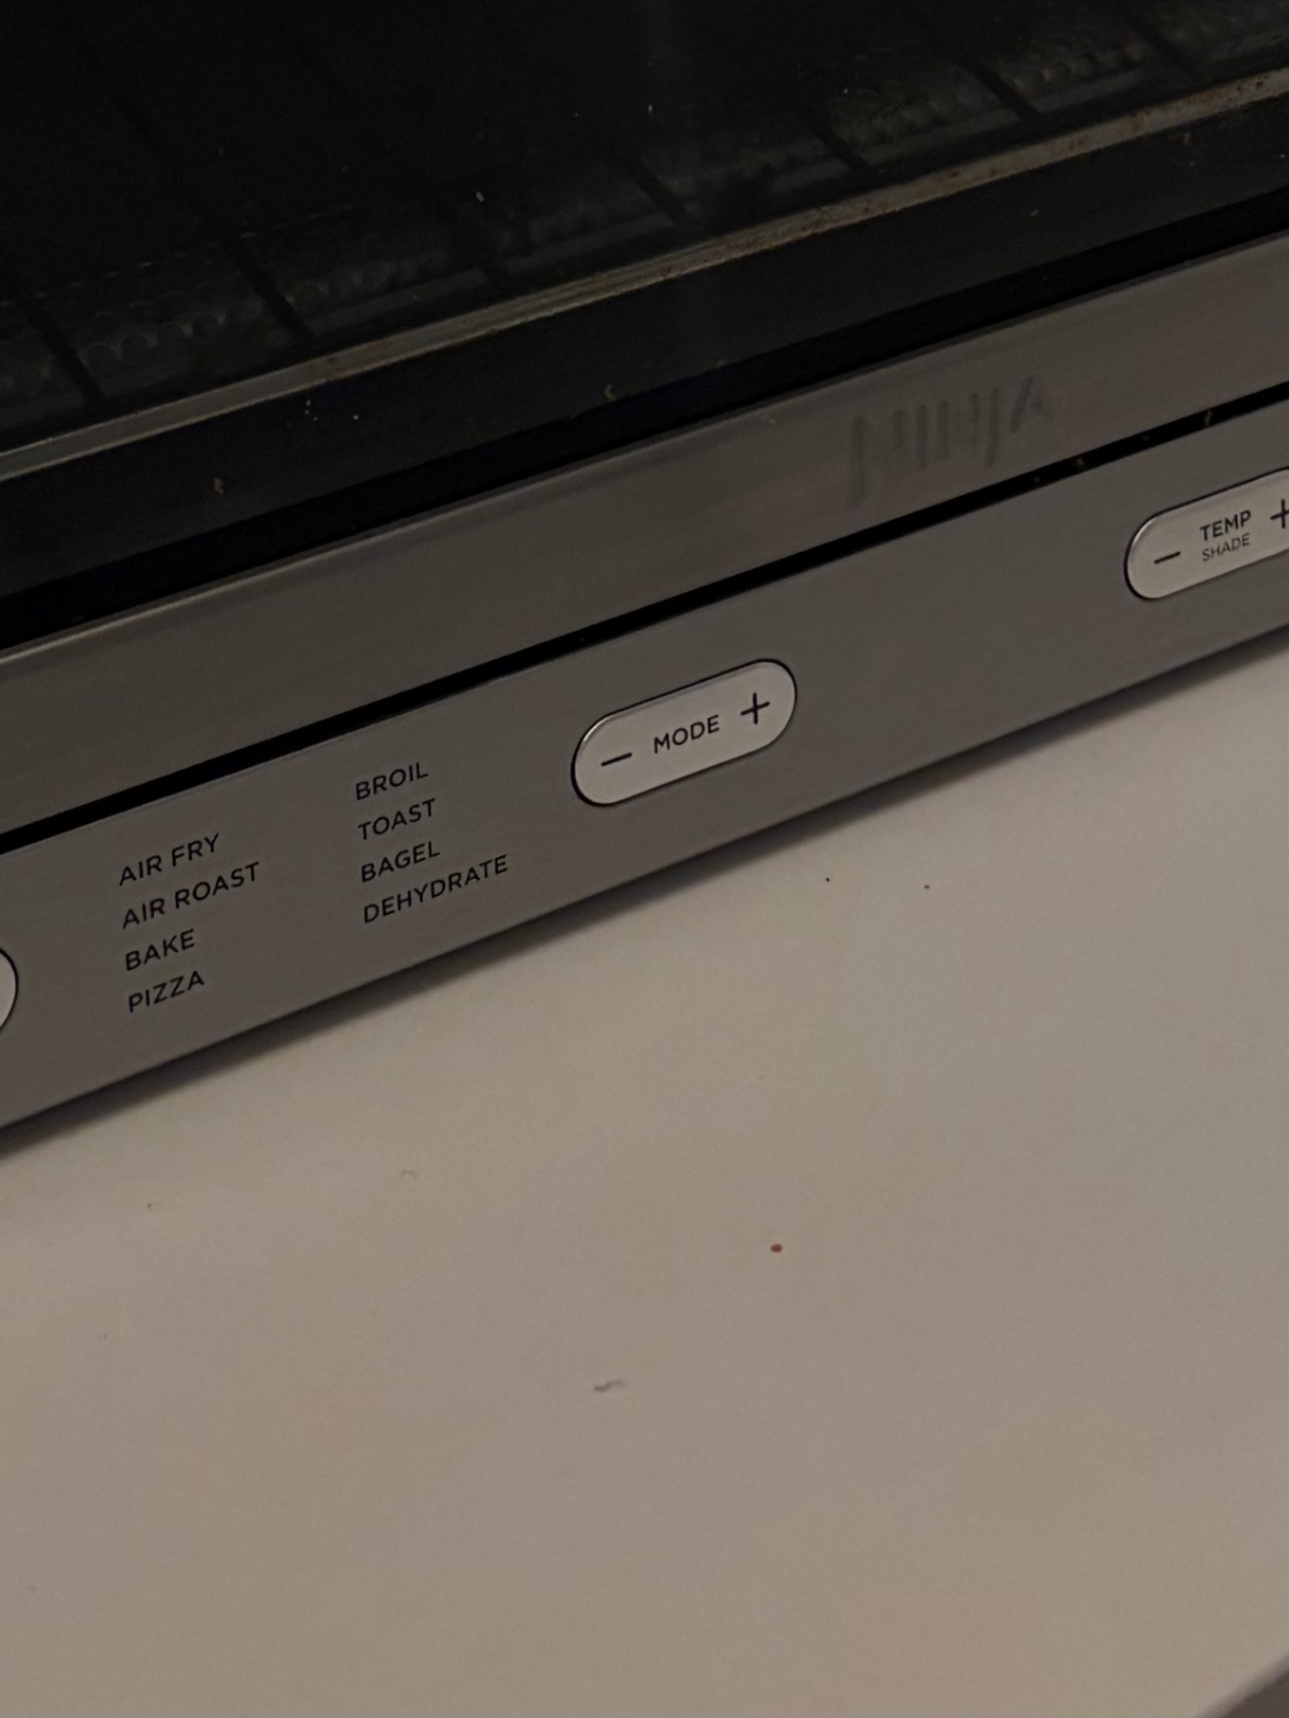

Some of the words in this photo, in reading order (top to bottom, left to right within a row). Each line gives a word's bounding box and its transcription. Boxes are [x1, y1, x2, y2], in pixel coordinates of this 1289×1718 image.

[847, 375, 1046, 509] NINJA
[1198, 509, 1253, 543] TEMP
[1201, 532, 1252, 563] SHADE
[653, 713, 721, 755] MODE
[355, 761, 430, 801] BROIL
[357, 797, 437, 841] TOAST
[118, 854, 164, 887] AIR
[171, 832, 220, 868] FRY
[360, 840, 441, 884] BAGEL
[122, 897, 166, 930] AIR
[174, 860, 261, 910] ROAST
[363, 853, 510, 925] DEHYDRATE
[124, 928, 197, 972] BAKE
[127, 970, 206, 1014] PIZZA
